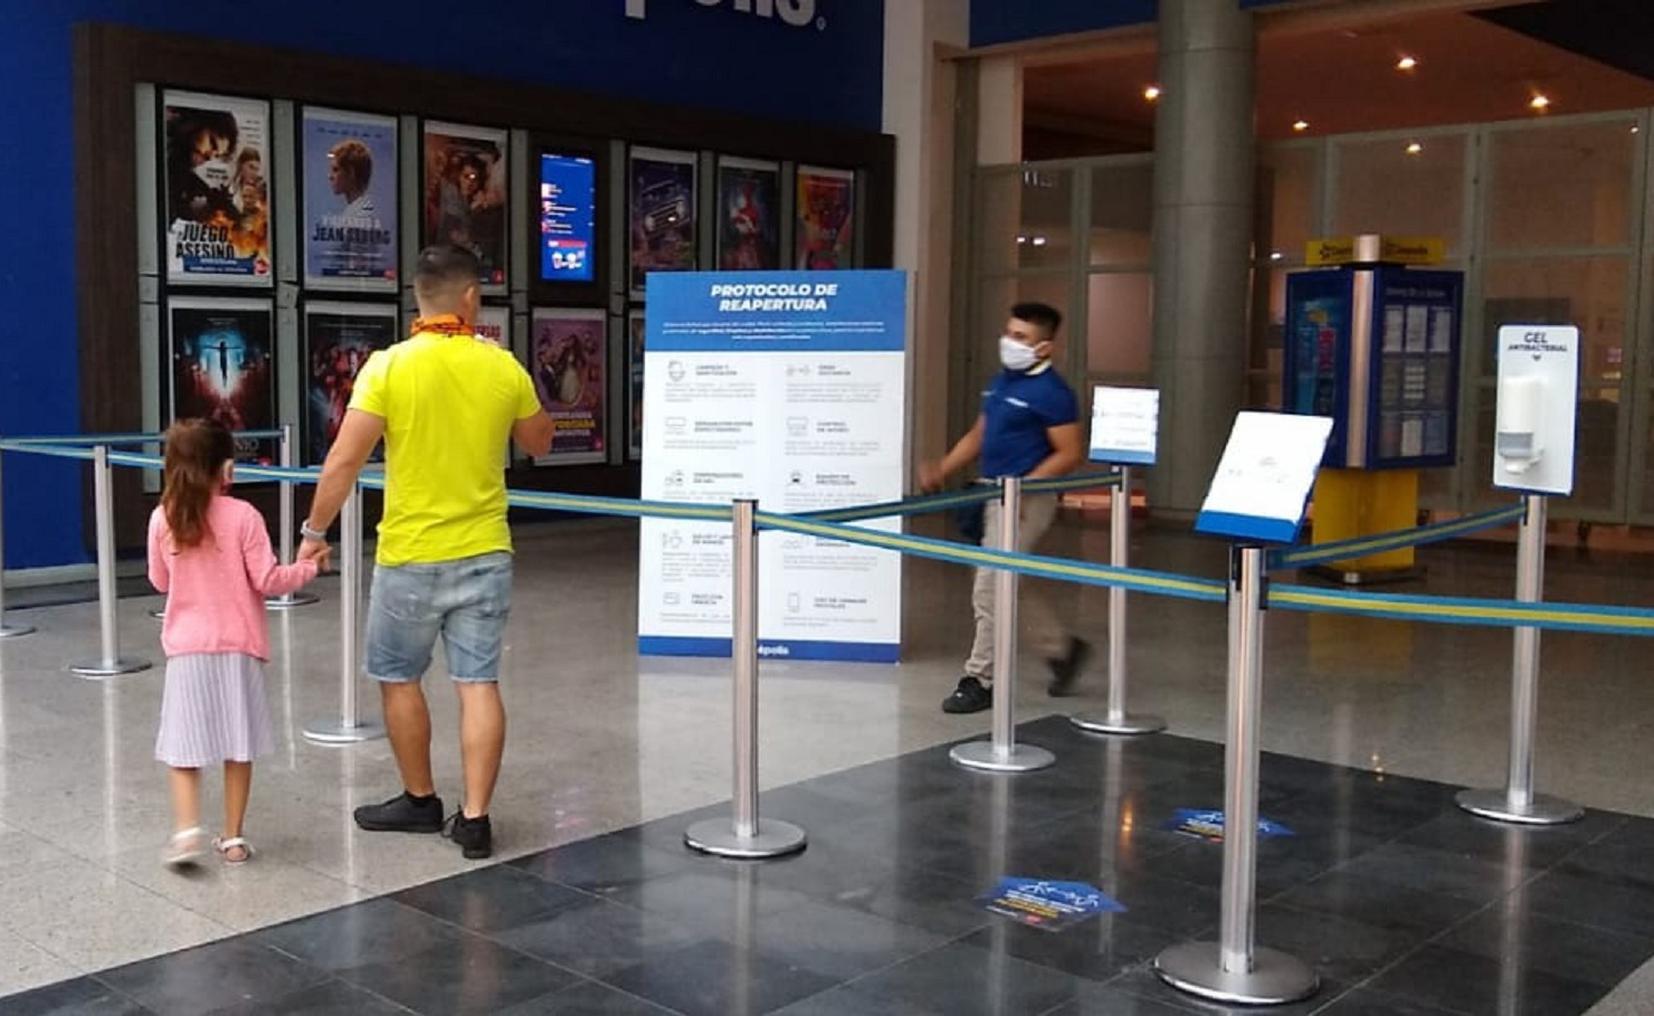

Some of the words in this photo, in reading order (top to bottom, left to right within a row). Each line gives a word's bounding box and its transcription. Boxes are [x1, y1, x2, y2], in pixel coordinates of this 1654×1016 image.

[182, 223, 229, 242] JUEGO
[313, 224, 344, 242] JEAN
[176, 242, 235, 260] ASESINO
[711, 284, 812, 297] PROTOCOLO
[814, 284, 838, 296] DE
[719, 298, 827, 312] REAPERTURA
[1507, 343, 1568, 352] ANTIBACTERIAL
